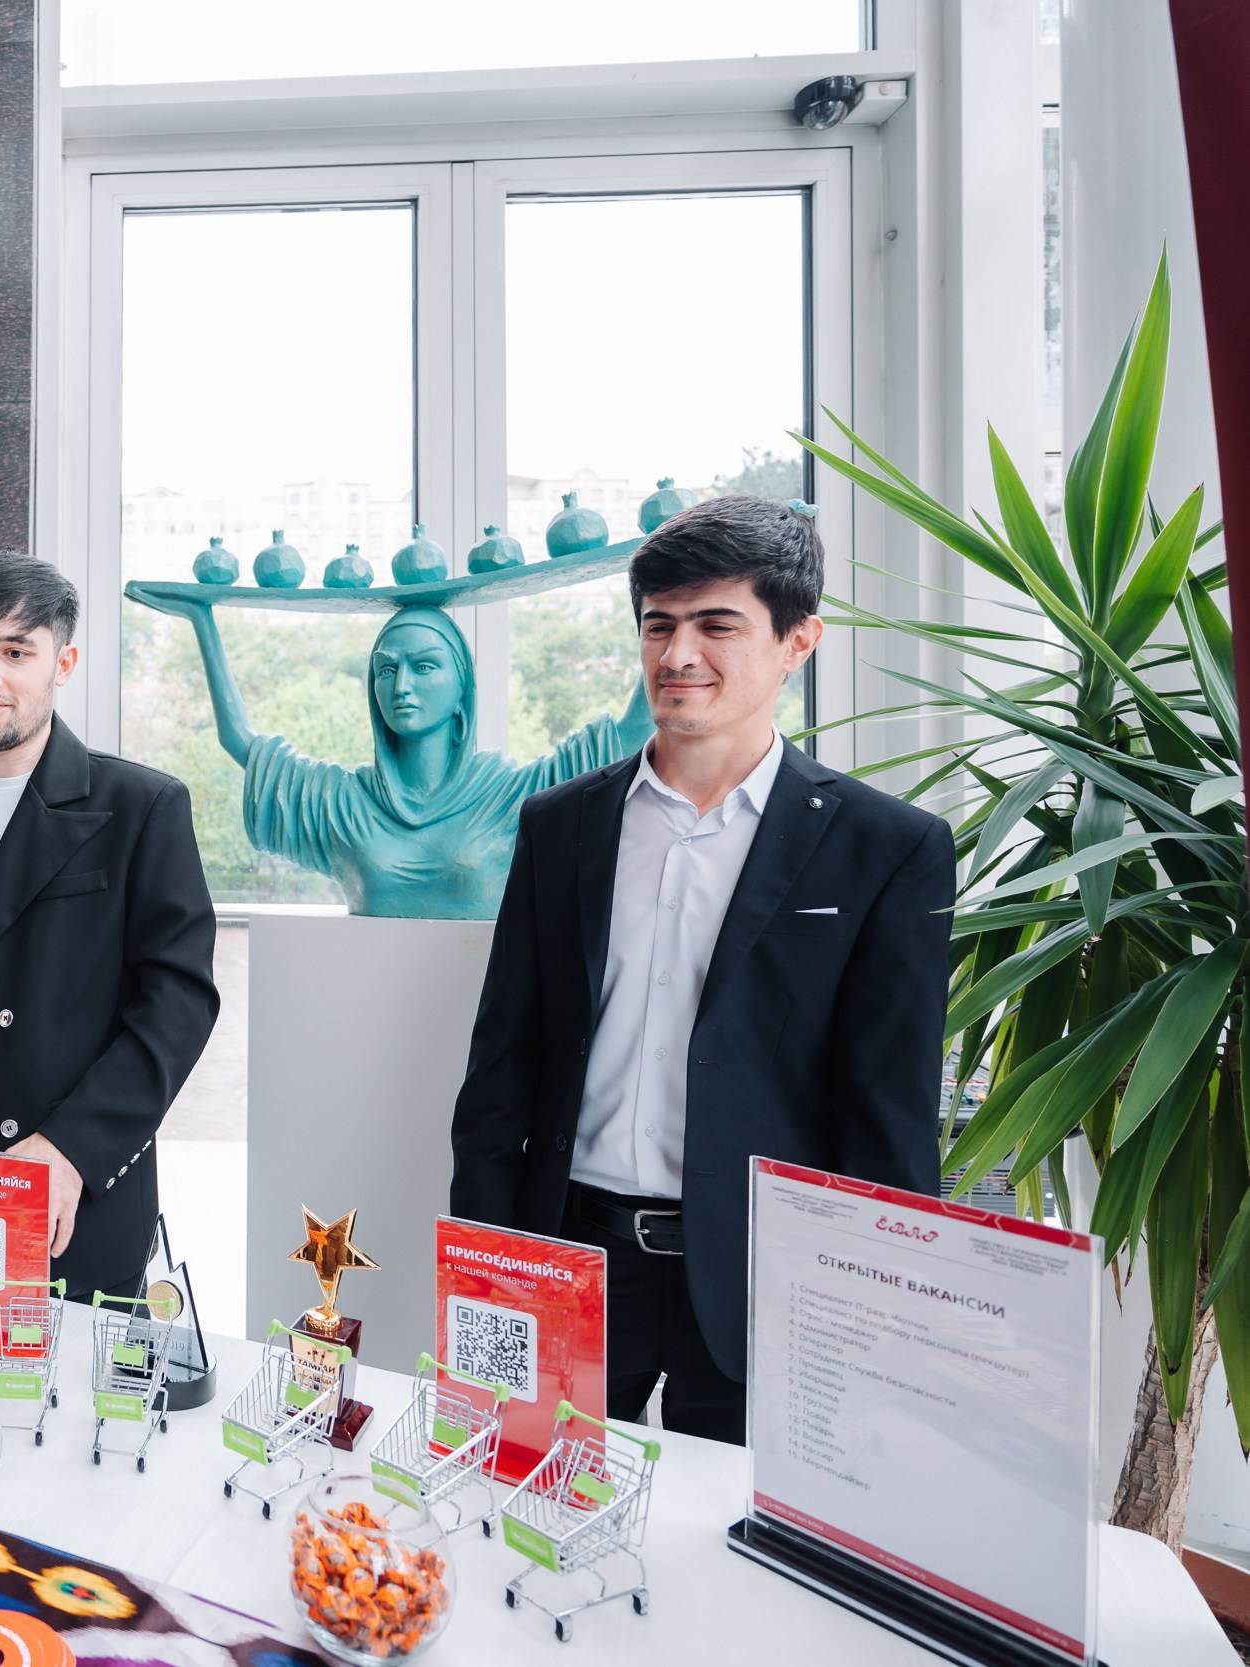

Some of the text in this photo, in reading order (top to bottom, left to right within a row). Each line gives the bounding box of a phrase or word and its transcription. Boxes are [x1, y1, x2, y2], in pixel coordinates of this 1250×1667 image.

[445, 1244, 573, 1282] ПРИСОЕДИНЯЙСЯ
[446, 1262, 537, 1290] к нашей команде
[799, 1285, 853, 1307] Специалист
[818, 1253, 1005, 1318] ОТКРЫТЫЕ ВАКАНСИИ
[798, 1333, 844, 1355] Оператор
[799, 1321, 871, 1352] Администратор
